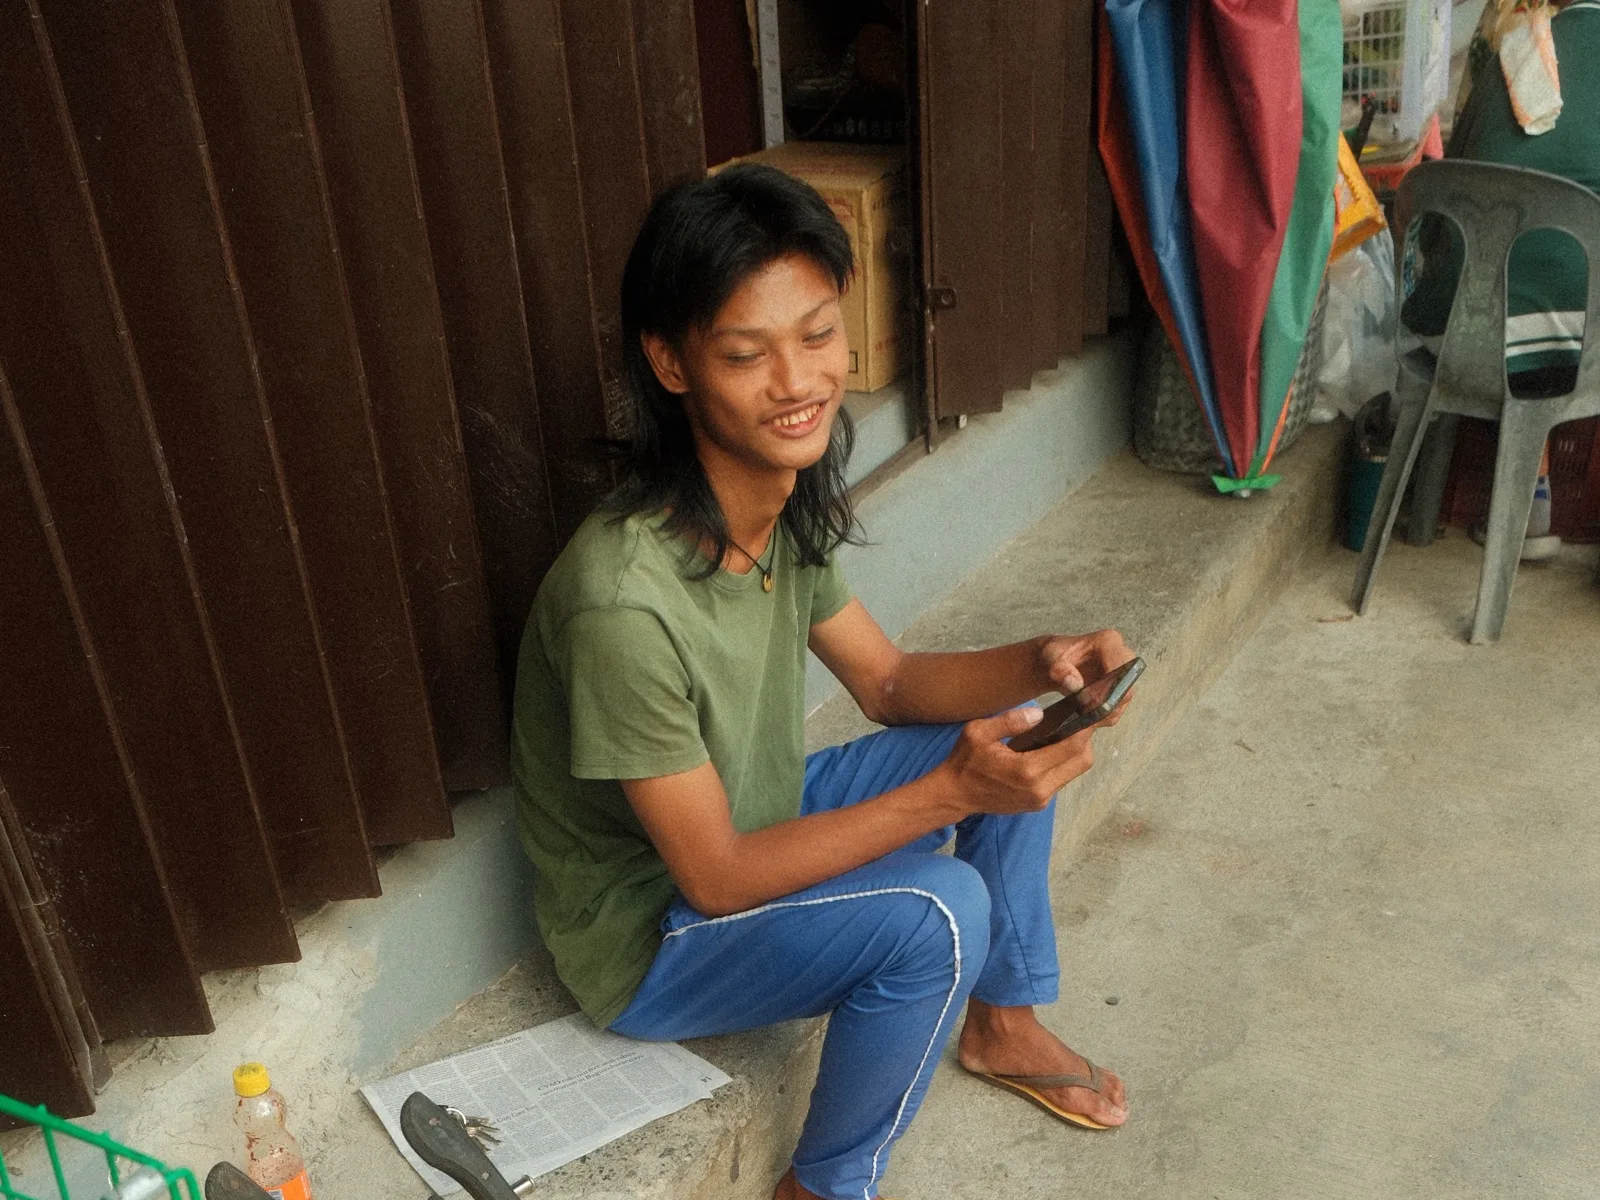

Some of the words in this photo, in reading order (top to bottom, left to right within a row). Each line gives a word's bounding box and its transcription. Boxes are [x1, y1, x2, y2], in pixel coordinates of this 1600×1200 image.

[503, 1035, 521, 1044] drive
[585, 1066, 610, 1079] Baguio
[538, 1080, 561, 1091] CVAO
